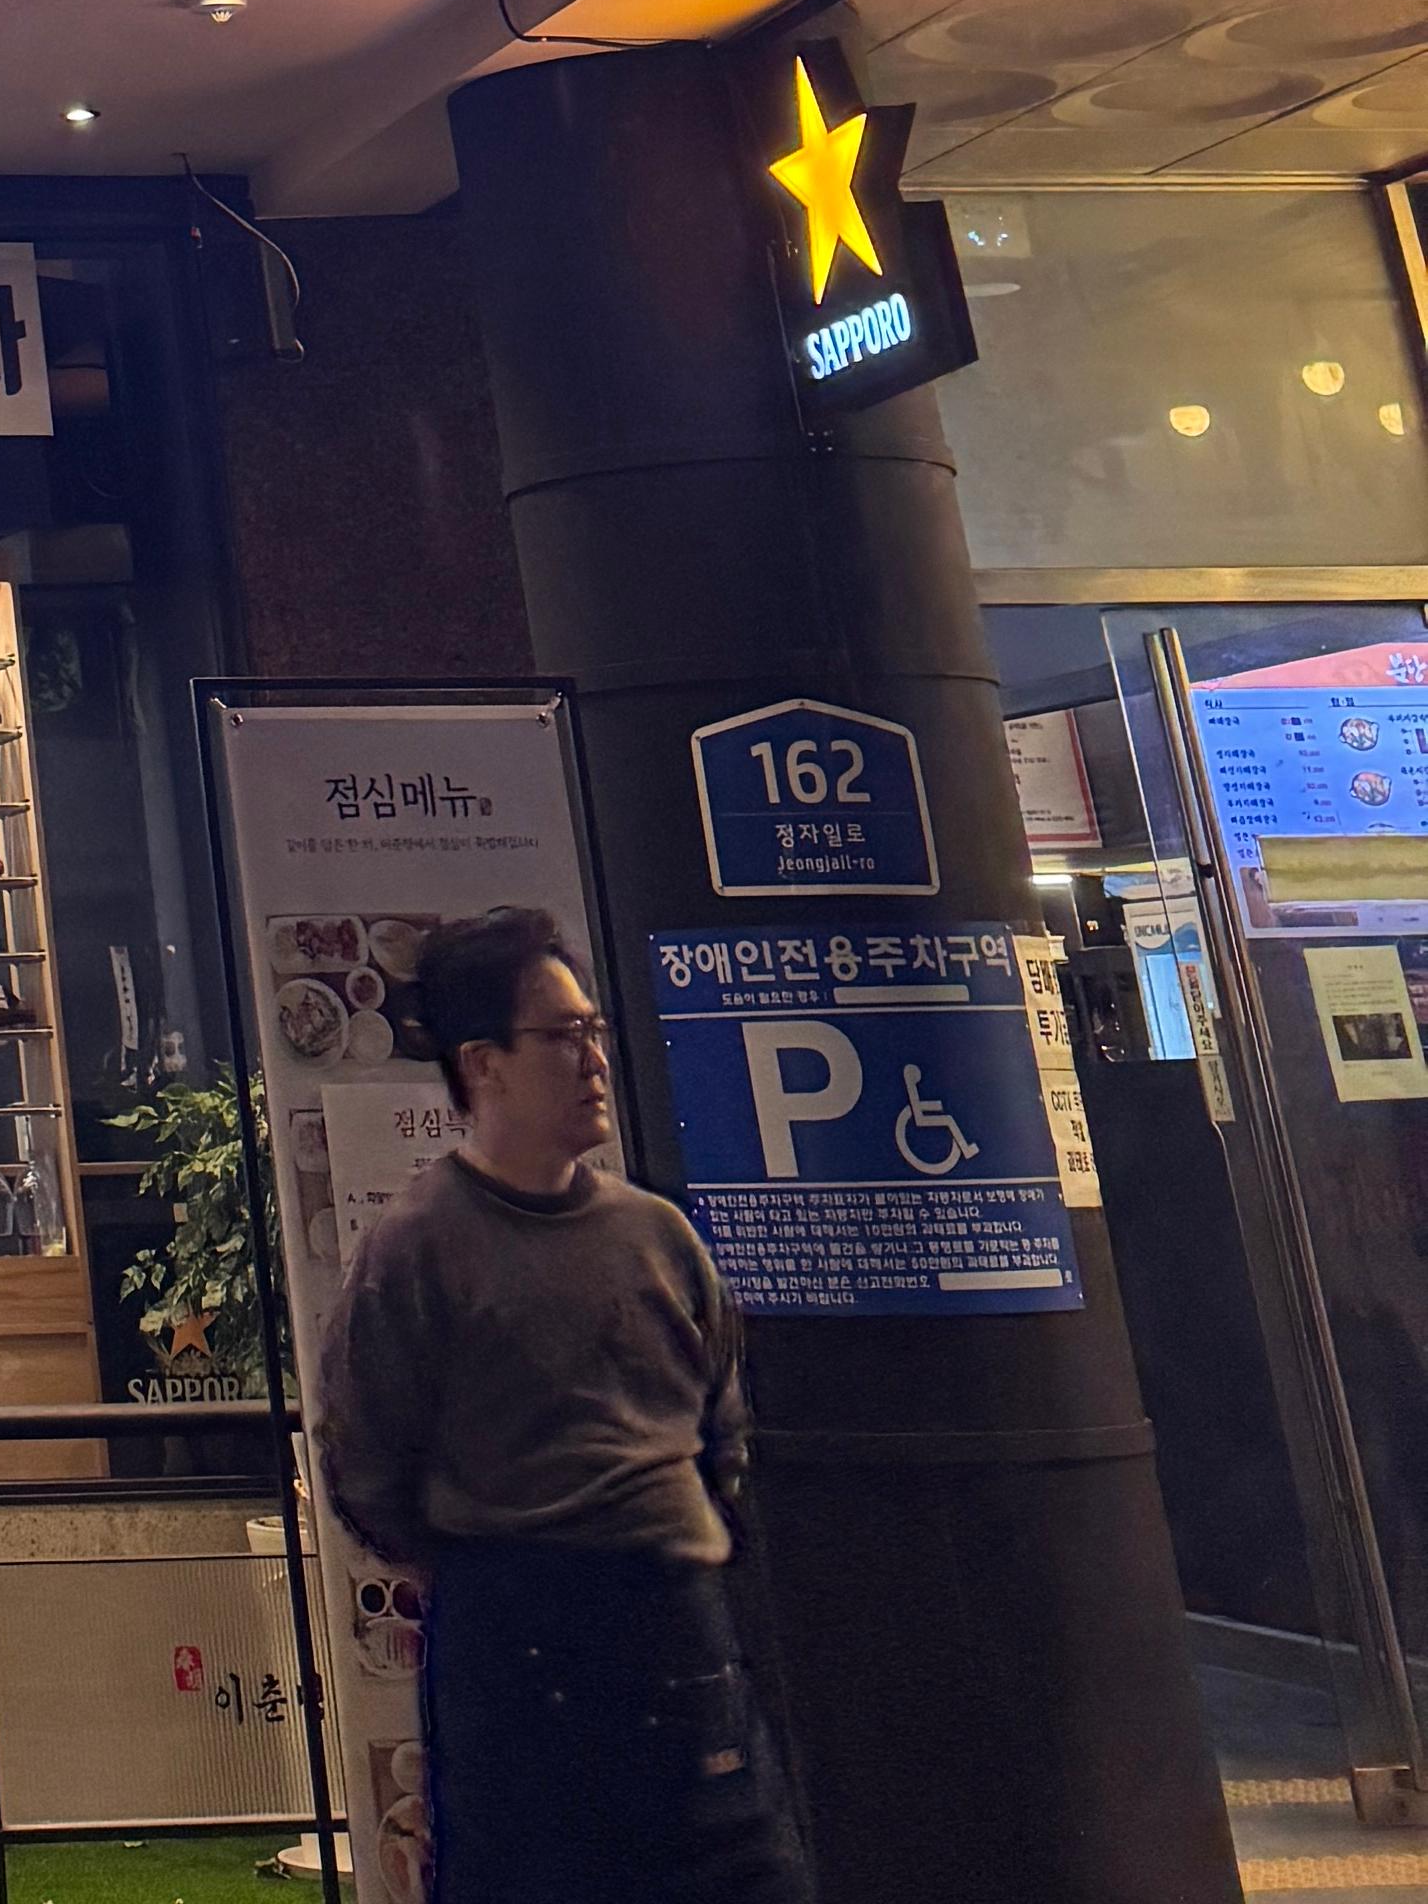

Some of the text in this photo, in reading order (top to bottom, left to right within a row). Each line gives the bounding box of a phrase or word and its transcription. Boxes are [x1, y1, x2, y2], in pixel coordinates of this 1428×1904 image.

[803, 292, 913, 381] SAPPORO
[324, 772, 477, 821] 점심메뉴
[749, 739, 872, 806] 162
[775, 822, 866, 848] 정자일로
[777, 854, 876, 873] Jeongjail-ro
[659, 932, 1012, 988] 장애인전용주차구역
[741, 1018, 864, 1180] P
[127, 1372, 244, 1404] SAPPOR
